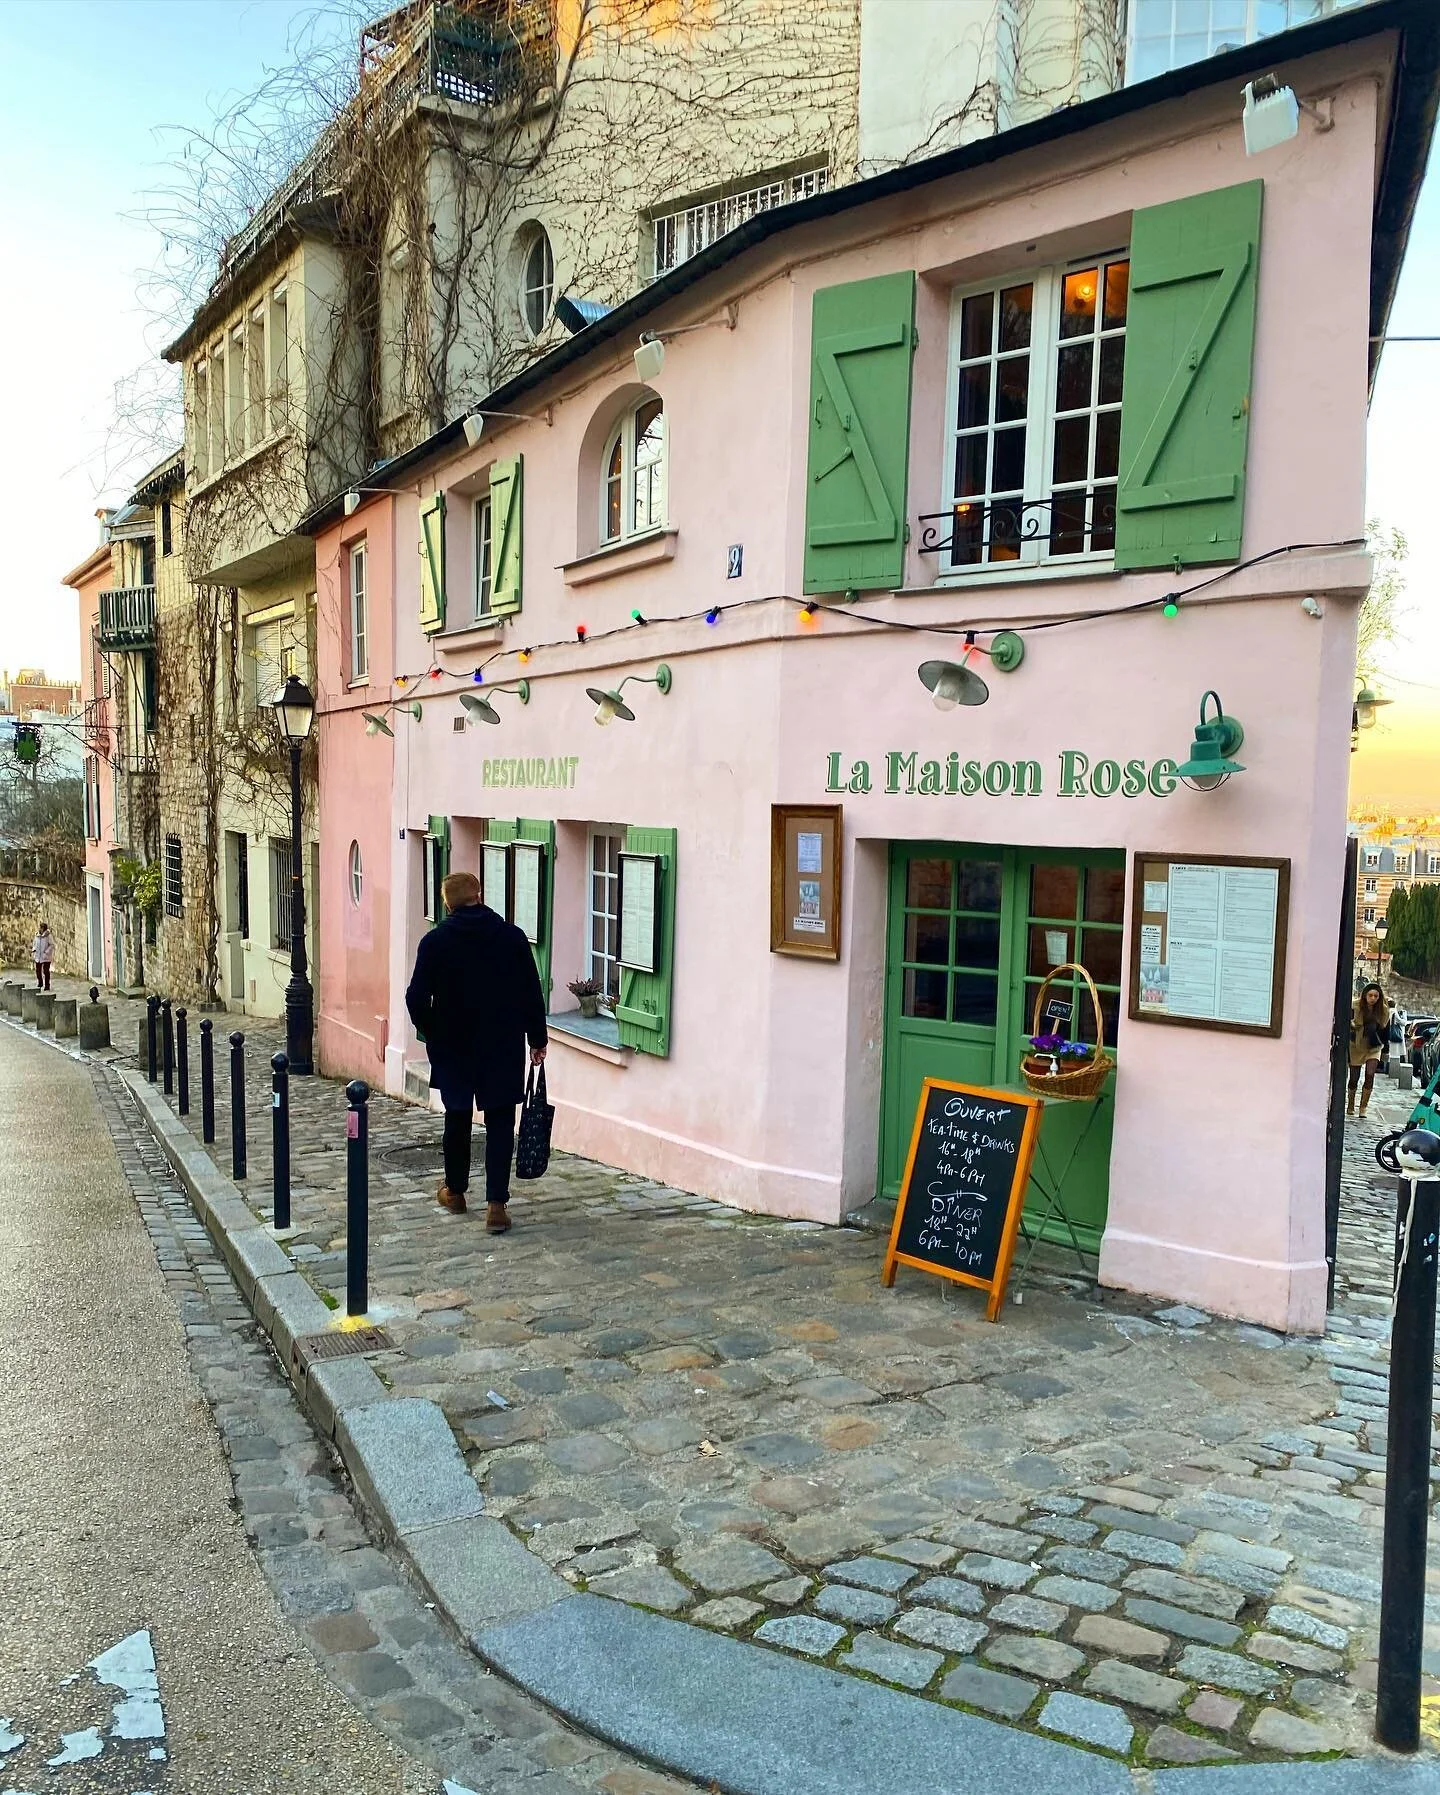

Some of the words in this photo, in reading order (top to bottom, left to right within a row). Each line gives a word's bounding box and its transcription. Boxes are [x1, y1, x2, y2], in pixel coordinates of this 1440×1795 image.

[481, 756, 579, 789] RESTAURANT
[825, 751, 873, 795] La
[884, 751, 1043, 797] Maison
[1057, 750, 1178, 799] Rose
[944, 1097, 1011, 1125] OUVERT
[980, 1134, 1015, 1153] DRINKS
